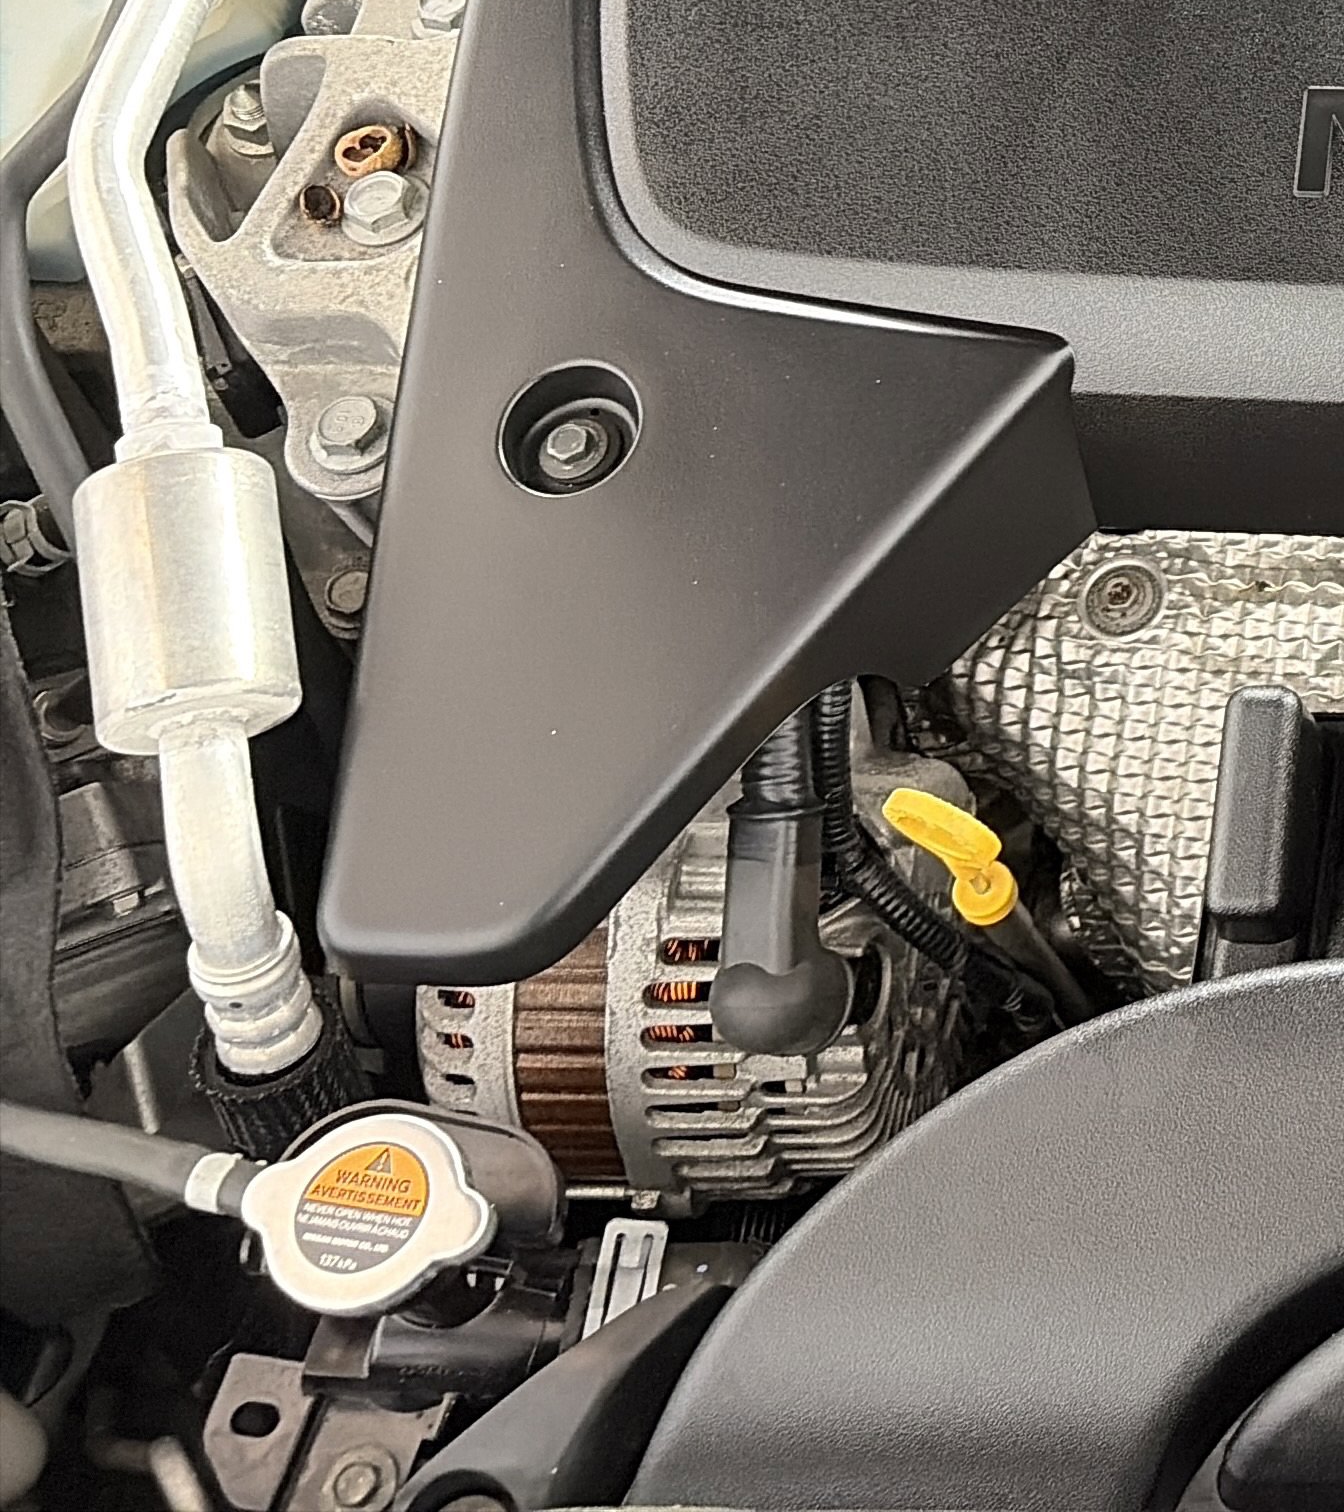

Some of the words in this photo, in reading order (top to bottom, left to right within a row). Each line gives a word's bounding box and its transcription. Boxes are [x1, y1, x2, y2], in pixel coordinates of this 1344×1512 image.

[335, 1168, 412, 1194] WARNING
[311, 1183, 422, 1210] AVERTISSEMENT
[303, 1202, 335, 1216] NEVER
[334, 1207, 361, 1219] OPEN
[361, 1211, 390, 1225] WHEN
[390, 1216, 413, 1227] HOT
